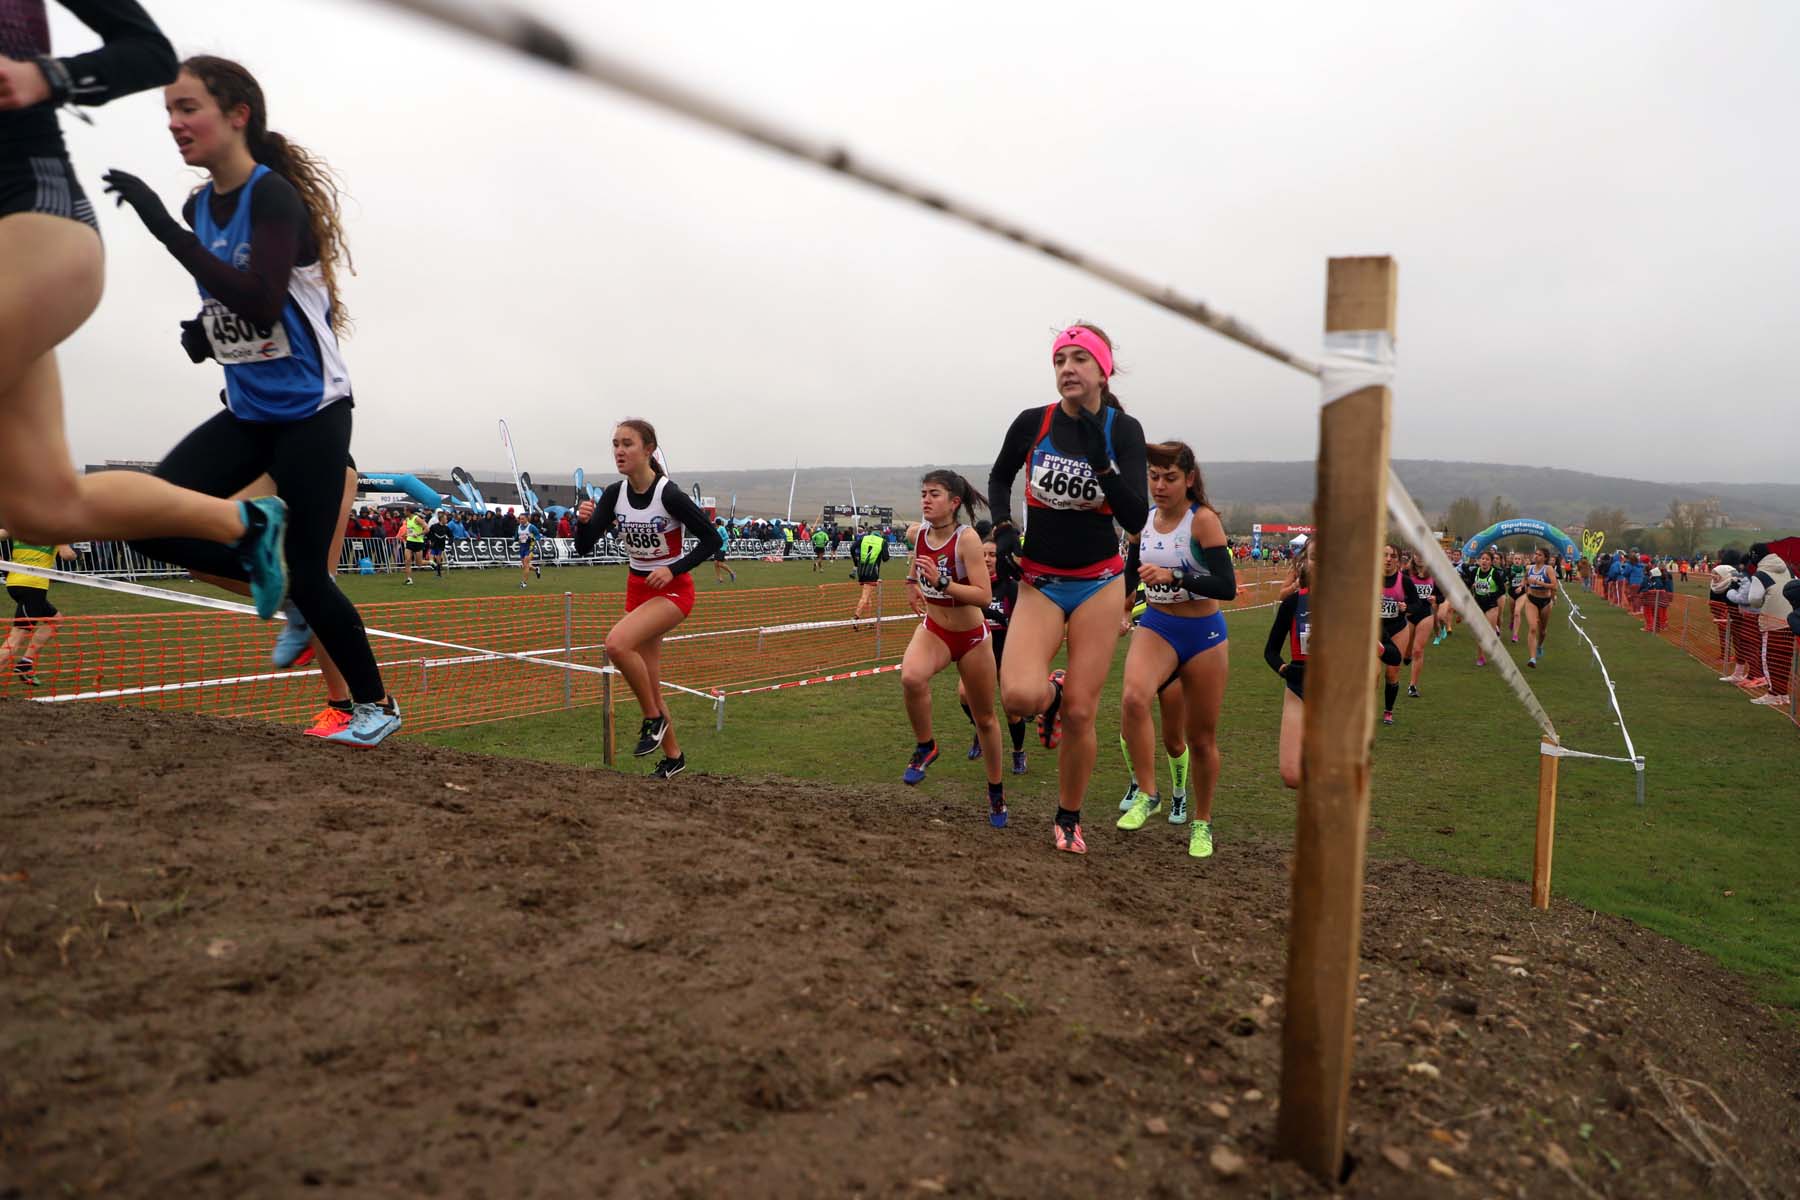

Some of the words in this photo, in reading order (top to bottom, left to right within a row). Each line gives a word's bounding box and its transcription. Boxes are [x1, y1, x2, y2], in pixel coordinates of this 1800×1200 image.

[1042, 461, 1092, 477] BURGO
[1044, 454, 1092, 470] DIPUTACI
[1039, 470, 1098, 500] 4666
[626, 533, 661, 549] 4586
